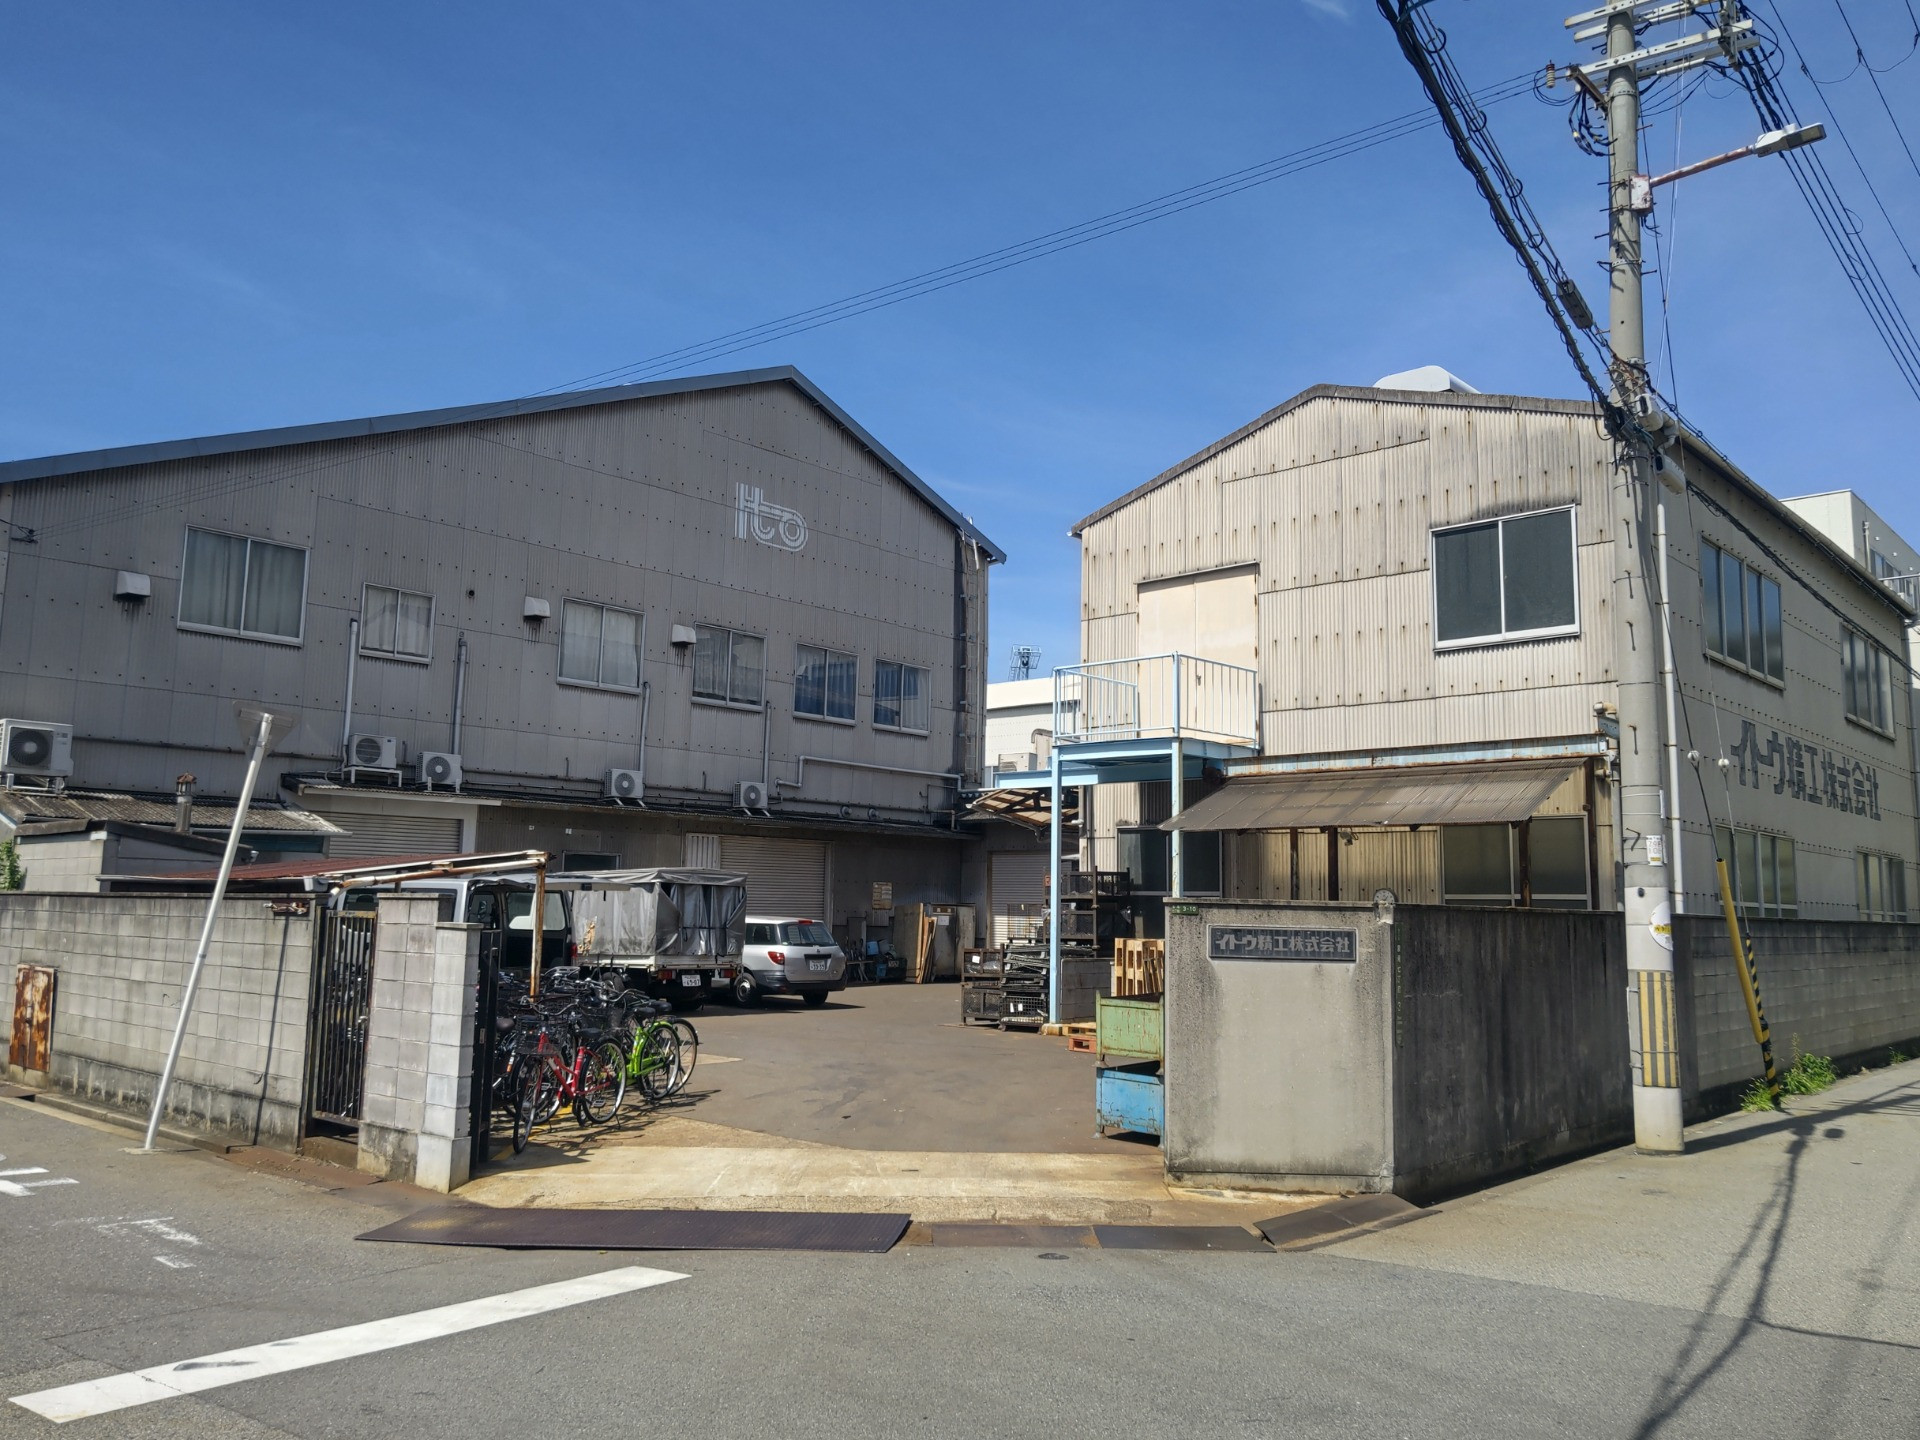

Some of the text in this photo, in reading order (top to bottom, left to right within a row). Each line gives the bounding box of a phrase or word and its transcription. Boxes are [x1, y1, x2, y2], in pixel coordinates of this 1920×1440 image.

[1731, 720, 1881, 821] イトウ精工株式会社
[1215, 934, 1350, 953] イトウ精工株式会社
